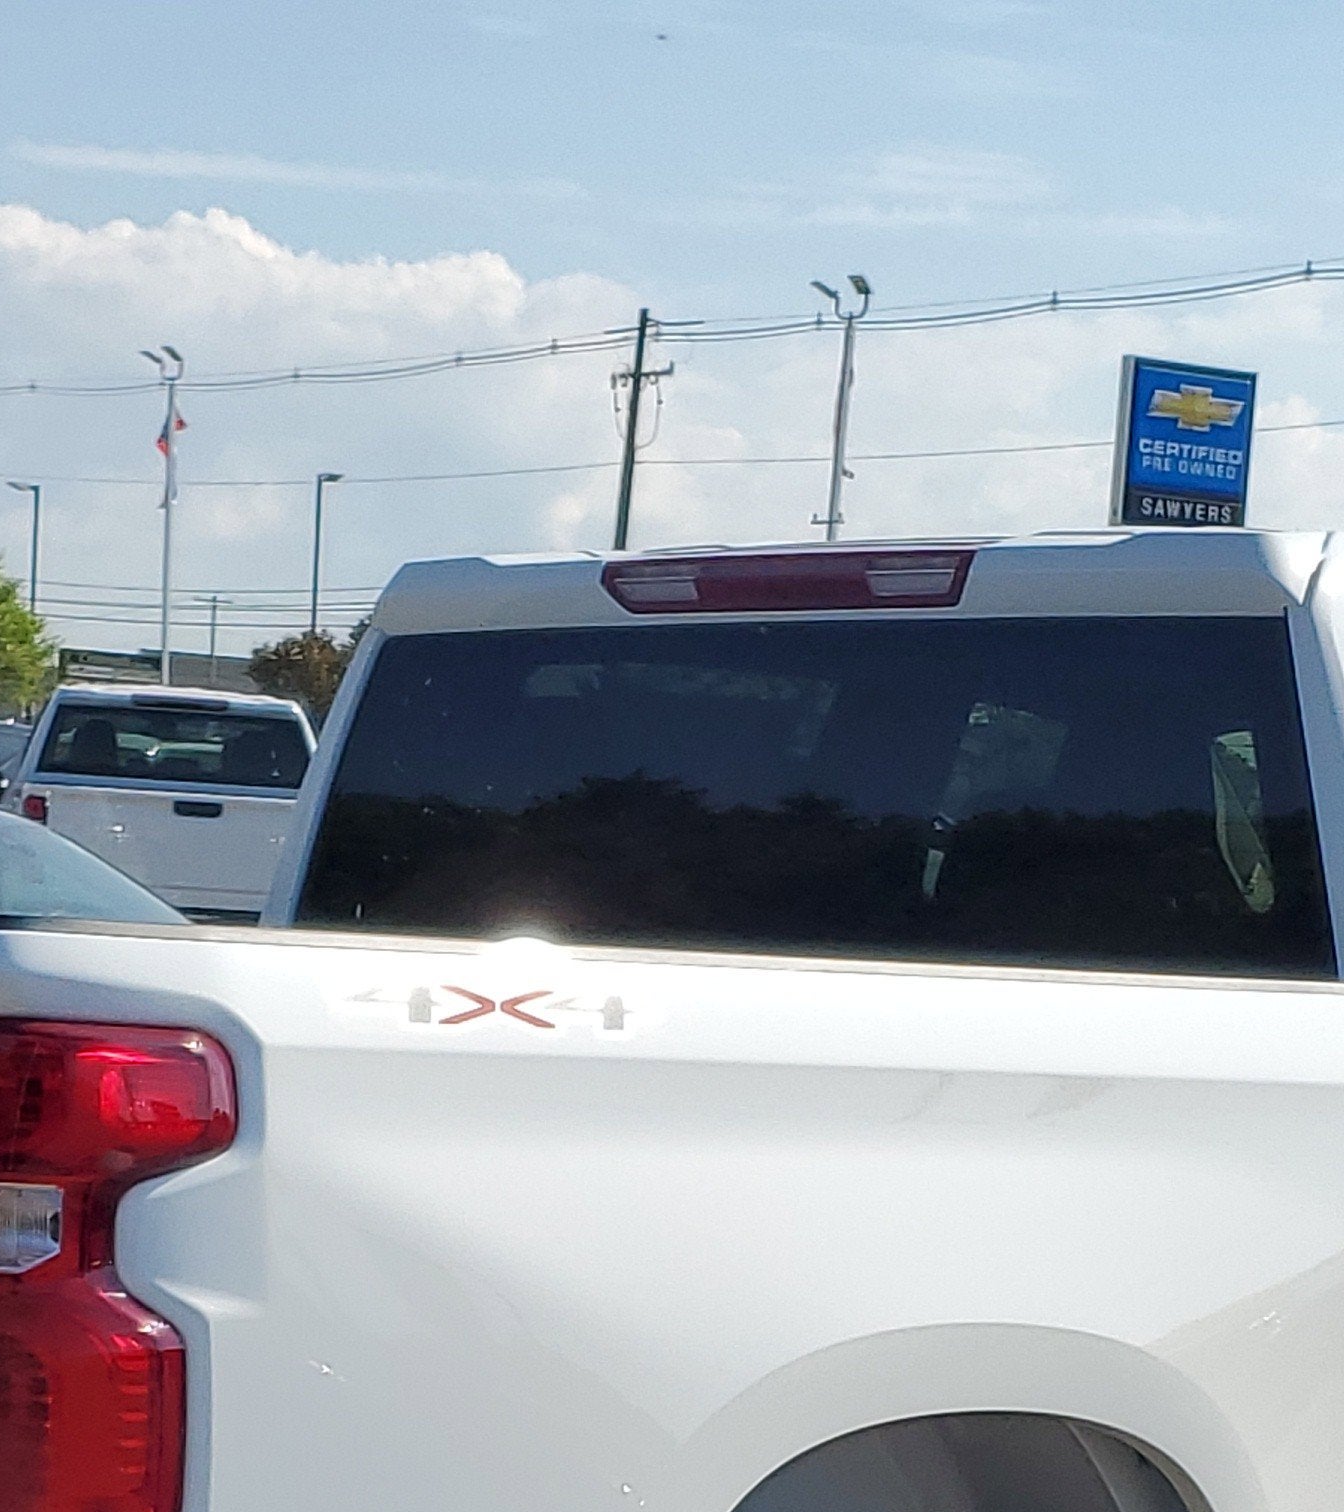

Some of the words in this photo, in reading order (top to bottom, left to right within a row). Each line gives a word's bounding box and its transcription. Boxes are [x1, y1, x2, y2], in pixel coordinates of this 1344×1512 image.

[1139, 438, 1243, 465] CERTIFIED
[1142, 455, 1170, 472] PRE
[1178, 459, 1237, 480] OWNED
[1141, 496, 1232, 524] SAWYERS
